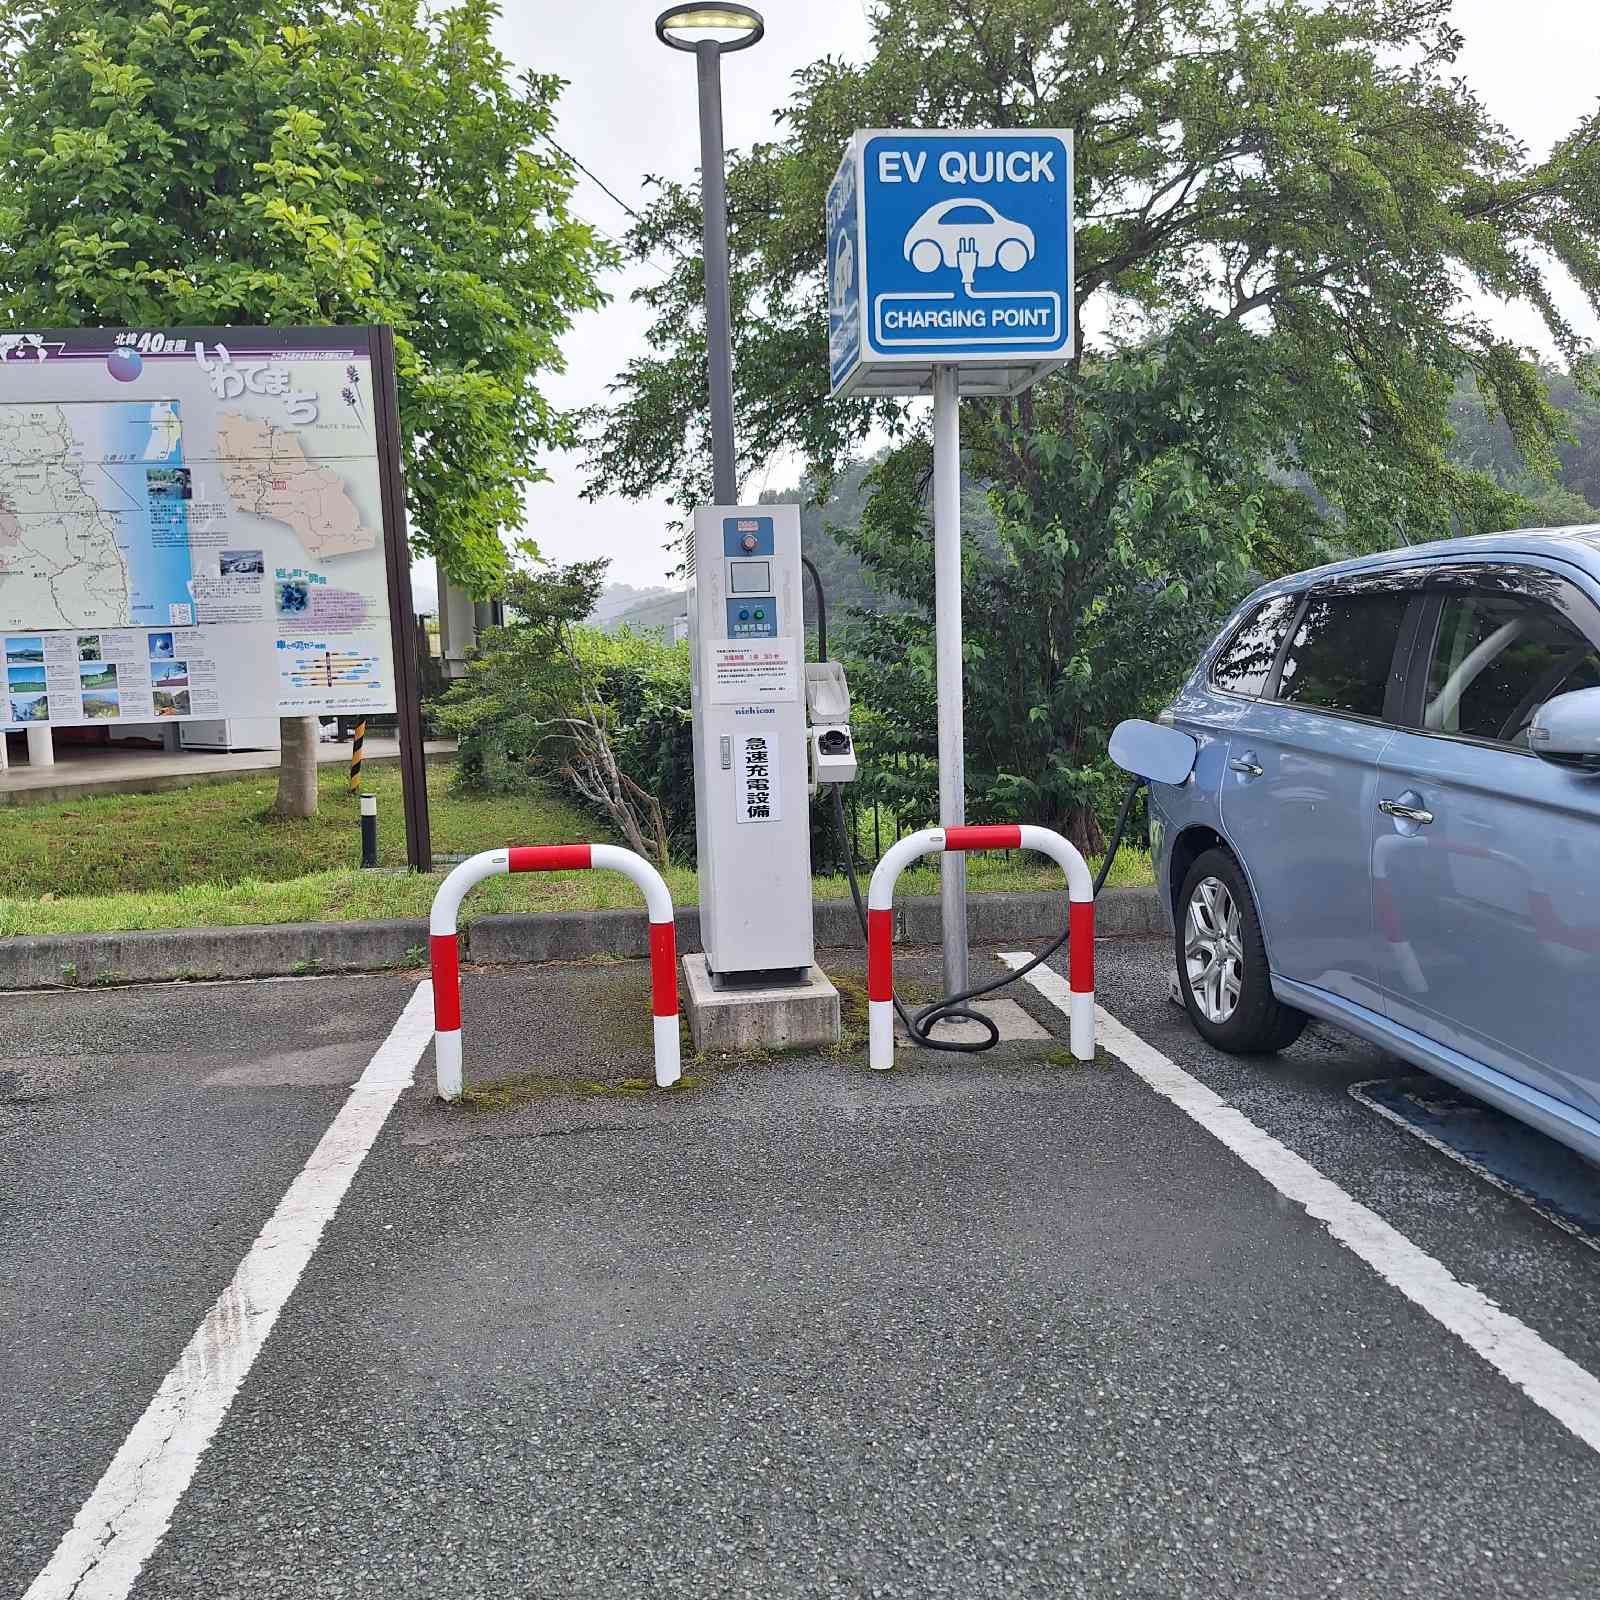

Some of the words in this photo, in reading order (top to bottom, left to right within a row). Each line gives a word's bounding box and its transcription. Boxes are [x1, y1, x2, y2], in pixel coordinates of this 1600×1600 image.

[878, 151, 927, 183] EV
[939, 151, 1055, 185] QUICK
[884, 309, 986, 329] CHARGING
[991, 308, 1051, 327] POINT
[744, 736, 771, 819] 急速充電設備
